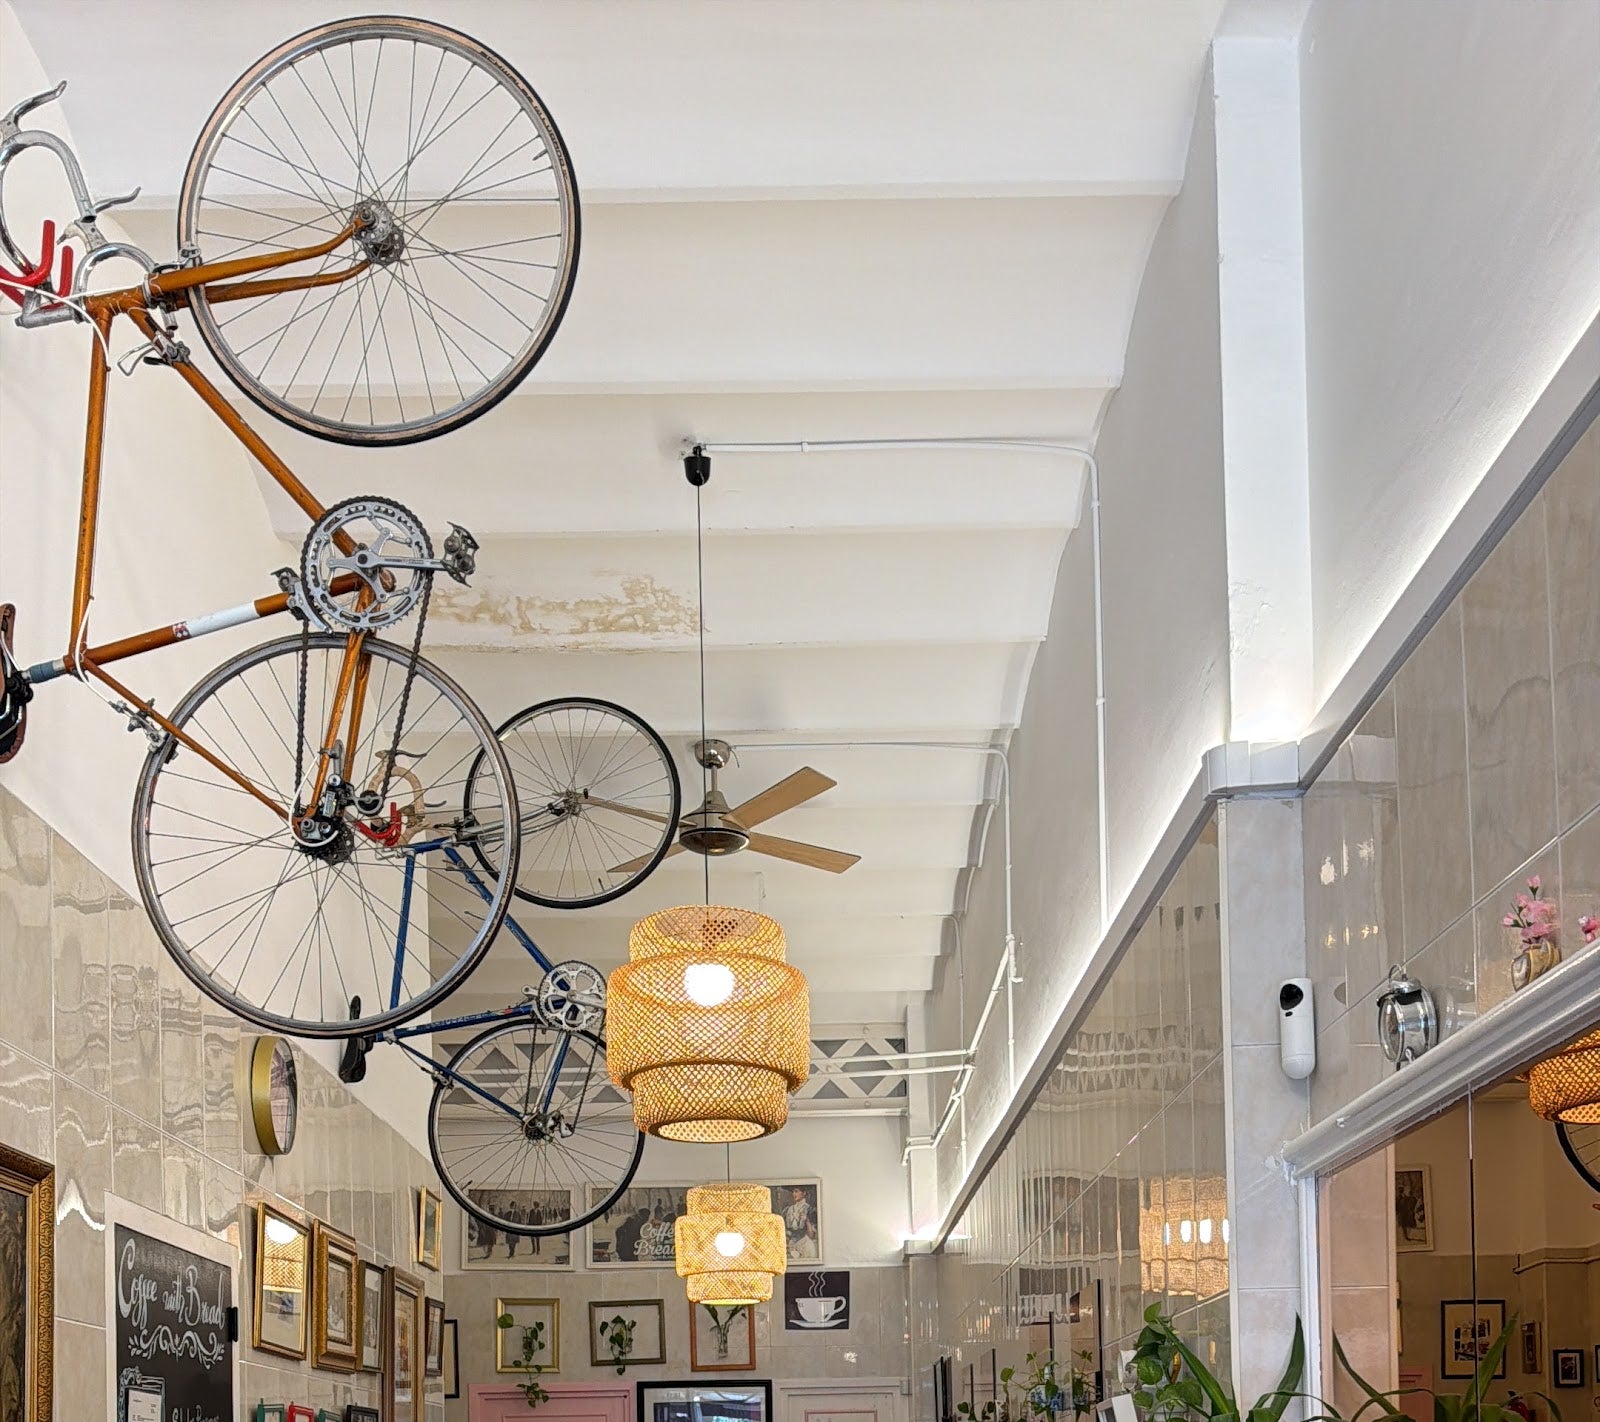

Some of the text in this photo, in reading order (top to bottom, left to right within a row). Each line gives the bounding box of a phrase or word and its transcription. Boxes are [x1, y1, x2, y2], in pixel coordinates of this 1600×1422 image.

[640, 1221, 675, 1242] Coffe
[118, 1238, 225, 1330] Coffee with Bread
